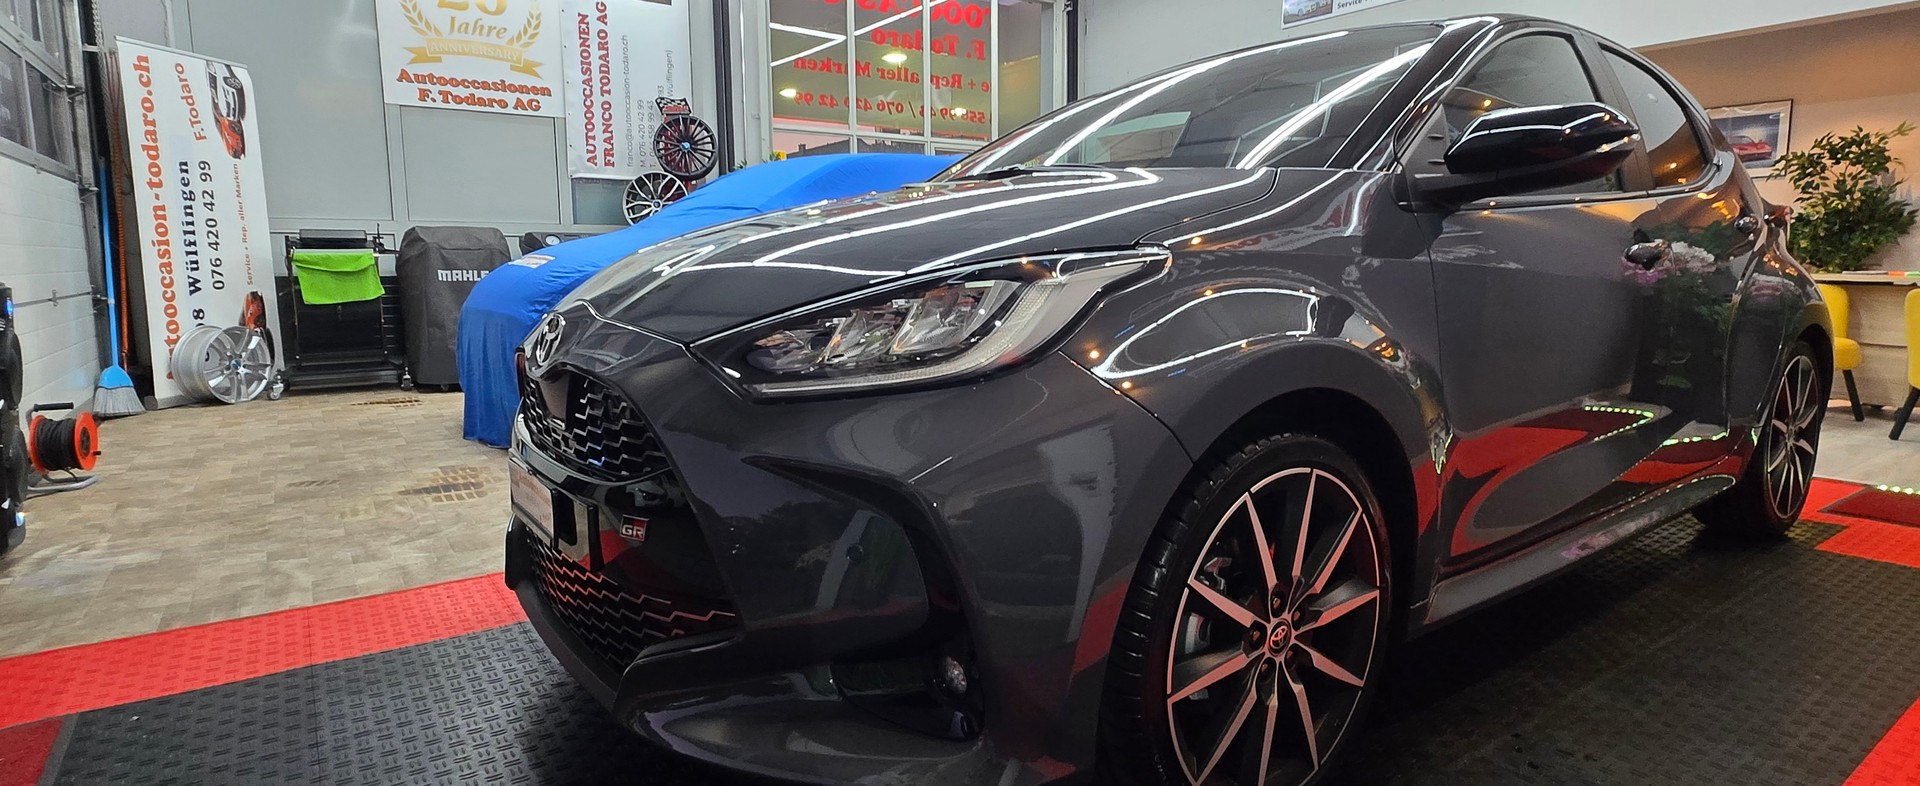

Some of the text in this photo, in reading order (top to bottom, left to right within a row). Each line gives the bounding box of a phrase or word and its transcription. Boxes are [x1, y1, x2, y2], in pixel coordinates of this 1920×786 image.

[448, 15, 508, 39] Jahre
[430, 42, 519, 62] ANNIVERSARY
[396, 68, 552, 97] Autooccasionen
[577, 12, 597, 167] AUTOOCCASIONEN
[595, 1, 615, 168] FRANCO TODARO AG
[417, 88, 541, 112] F. Todaro AG
[636, 99, 645, 110] 99
[637, 111, 645, 122] 42
[638, 123, 646, 140] 420
[233, 163, 242, 198] Marken
[132, 54, 183, 379] tooccasion-todaro.ch
[238, 201, 246, 221] aller
[178, 161, 203, 296] Wülflingen
[198, 160, 226, 290] 076 420 42 99
[243, 251, 254, 286] Service
[622, 524, 644, 537] GR
